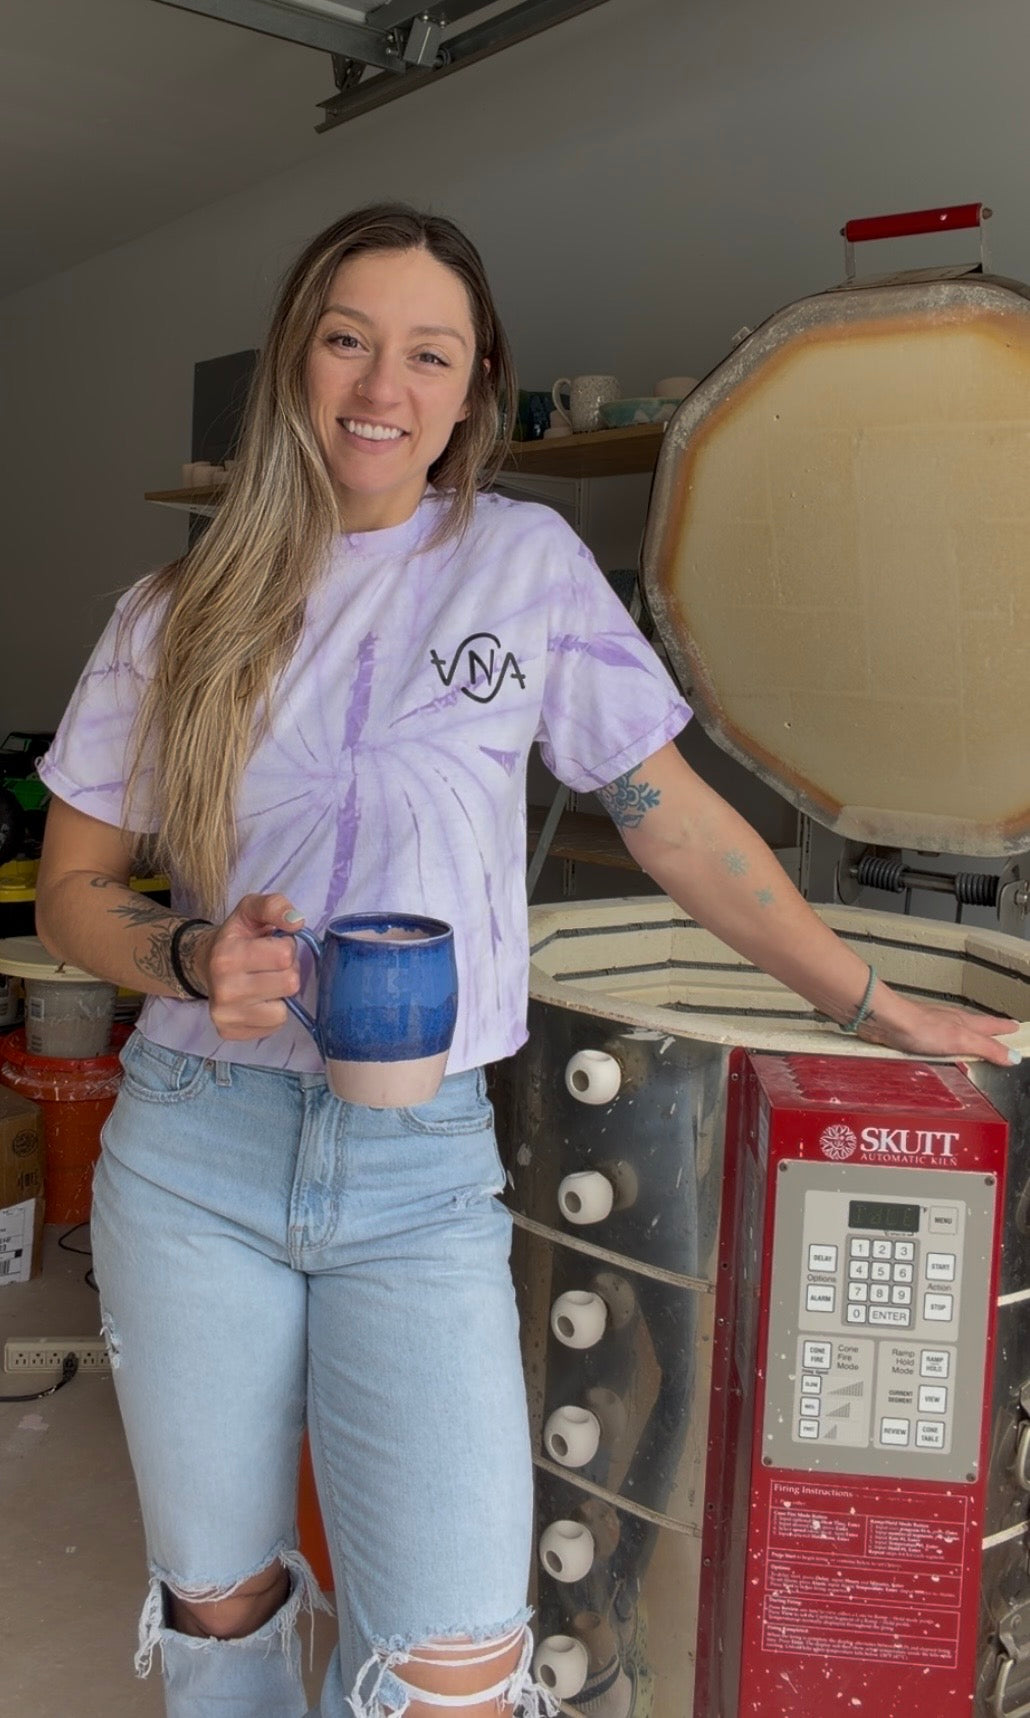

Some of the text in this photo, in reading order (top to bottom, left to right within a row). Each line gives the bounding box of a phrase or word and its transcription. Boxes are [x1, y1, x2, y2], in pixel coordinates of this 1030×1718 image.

[860, 1127, 960, 1157] SKUTT
[861, 1152, 928, 1165] AUTOMATIC
[934, 1216, 953, 1225] MENU
[878, 1245, 886, 1254] 2
[900, 1246, 908, 1256] 3
[855, 1265, 907, 1278] 4 5 6
[931, 1263, 950, 1271] START
[807, 1274, 837, 1283] Options
[928, 1283, 952, 1291] Action
[810, 1294, 832, 1302] ALARM
[855, 1287, 906, 1300] 7 8 9
[930, 1303, 947, 1311] STOP
[853, 1309, 907, 1321] 0 ENTER
[837, 1344, 859, 1353] Cone
[892, 1348, 915, 1358] Ramp
[837, 1353, 852, 1361] Fire
[837, 1362, 859, 1370] Mode
[896, 1358, 915, 1366] Hold
[891, 1366, 914, 1375] Mode
[924, 1395, 941, 1403] VIEW
[883, 1427, 907, 1435] REVIEW
[774, 1483, 854, 1498] Firing Instructions
